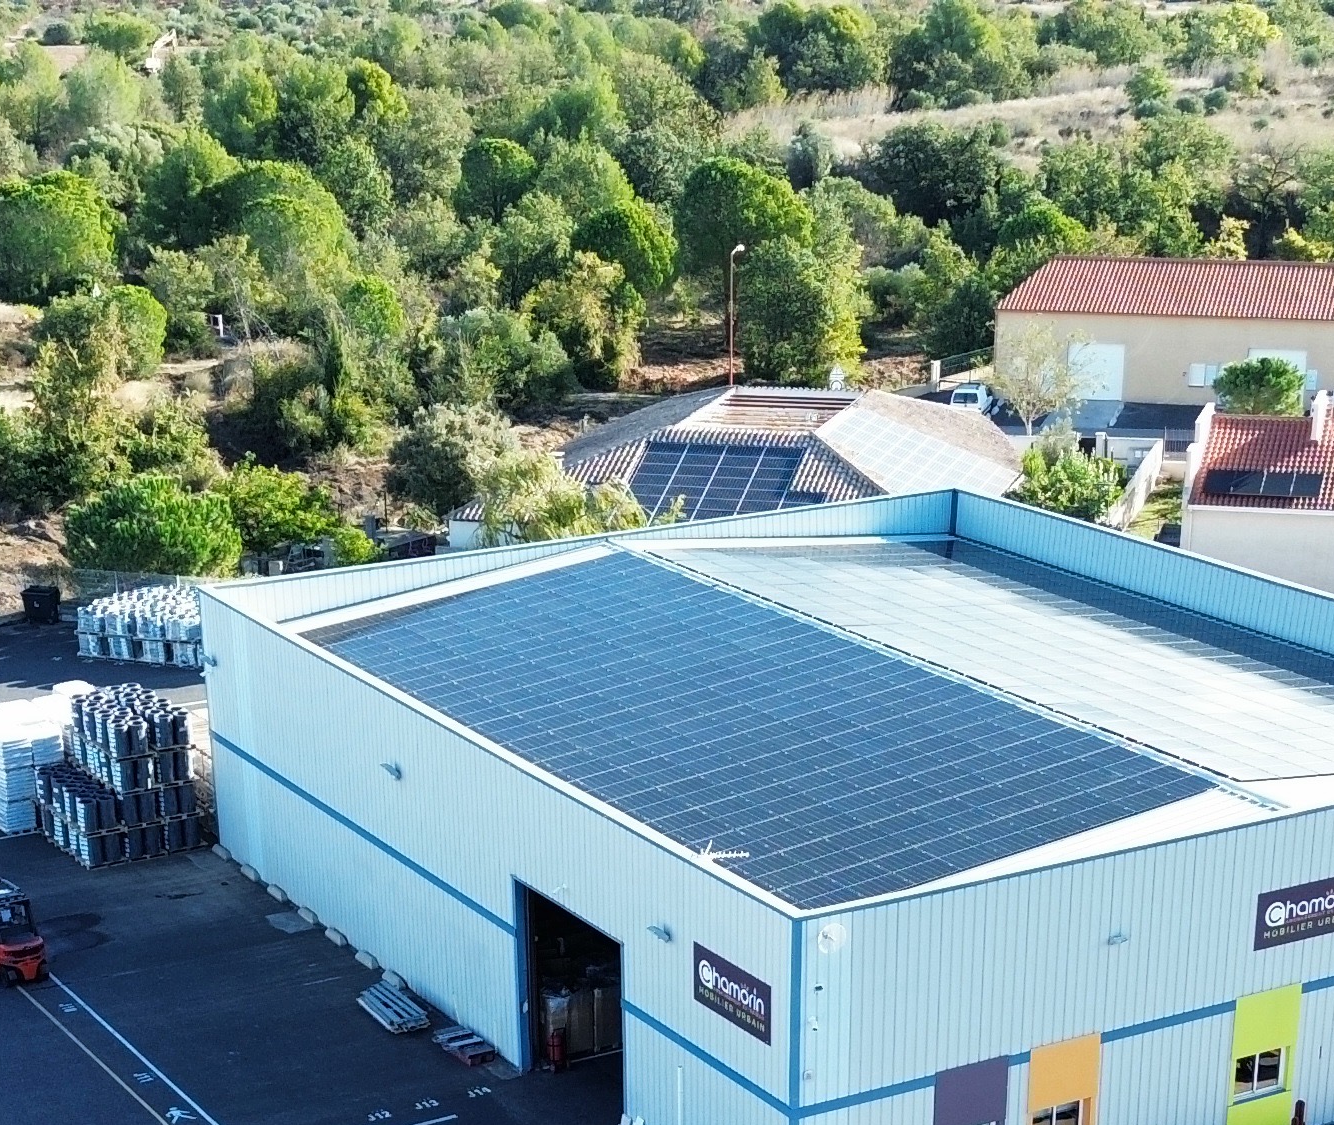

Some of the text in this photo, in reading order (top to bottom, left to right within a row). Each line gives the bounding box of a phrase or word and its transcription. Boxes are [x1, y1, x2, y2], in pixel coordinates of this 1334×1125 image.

[1263, 921, 1313, 939] MOBILIER
[698, 985, 734, 1013] MOBILIER
[736, 1008, 765, 1033] URBAIN
